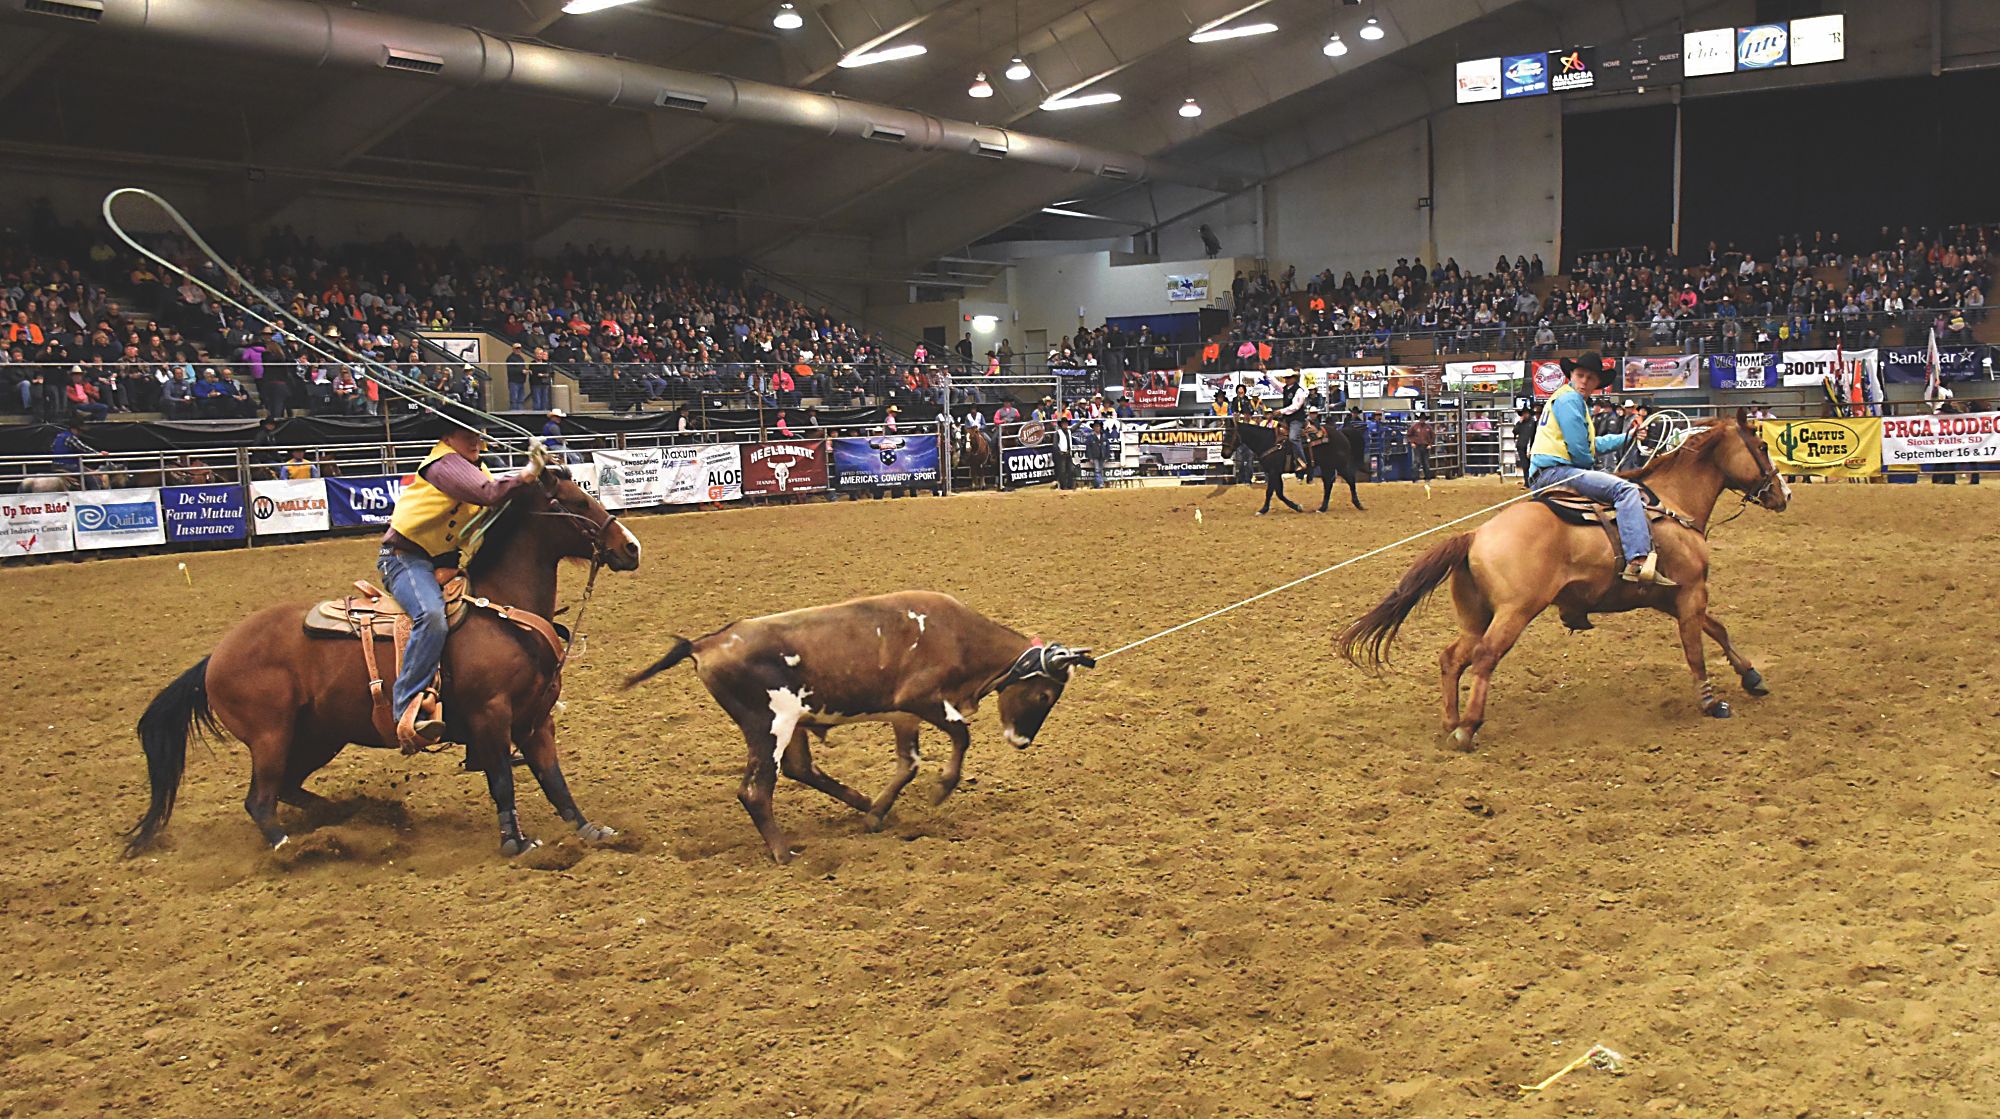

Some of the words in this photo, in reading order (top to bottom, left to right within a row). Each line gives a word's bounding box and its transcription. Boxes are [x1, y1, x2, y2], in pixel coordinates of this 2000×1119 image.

[1602, 60, 1620, 68] HOME
[1736, 355, 1774, 367] HOMES
[1889, 351, 1957, 364] Banktar
[1784, 361, 1826, 375] BOOT
[1884, 419, 1934, 438] PRCA
[1938, 416, 2000, 437] RODEO
[1140, 431, 1223, 444] ALUMINUM
[1907, 438, 1936, 446] Sioux
[1968, 436, 1983, 444] SD
[662, 448, 697, 460] Maxum
[1894, 448, 1954, 461] September
[1957, 447, 1970, 457] 16
[1973, 448, 1981, 456] &
[1983, 446, 1997, 456] 17
[1008, 453, 1055, 471] CINCH
[708, 470, 741, 486] ALOE
[840, 475, 879, 485] AMERICA'S
[881, 473, 912, 483] COWBOY
[914, 472, 937, 481] SPORT
[1105, 469, 1114, 477] of
[179, 493, 195, 505] De
[198, 492, 228, 504] Smet
[349, 487, 388, 510] LAS
[2, 505, 17, 519] Up
[19, 504, 42, 515] Your
[275, 499, 327, 512] WALKER
[166, 508, 197, 520] Farm
[200, 506, 243, 519] Mutual
[10, 527, 40, 536] Industry
[41, 524, 68, 533] Council
[176, 524, 235, 536] Insurance
